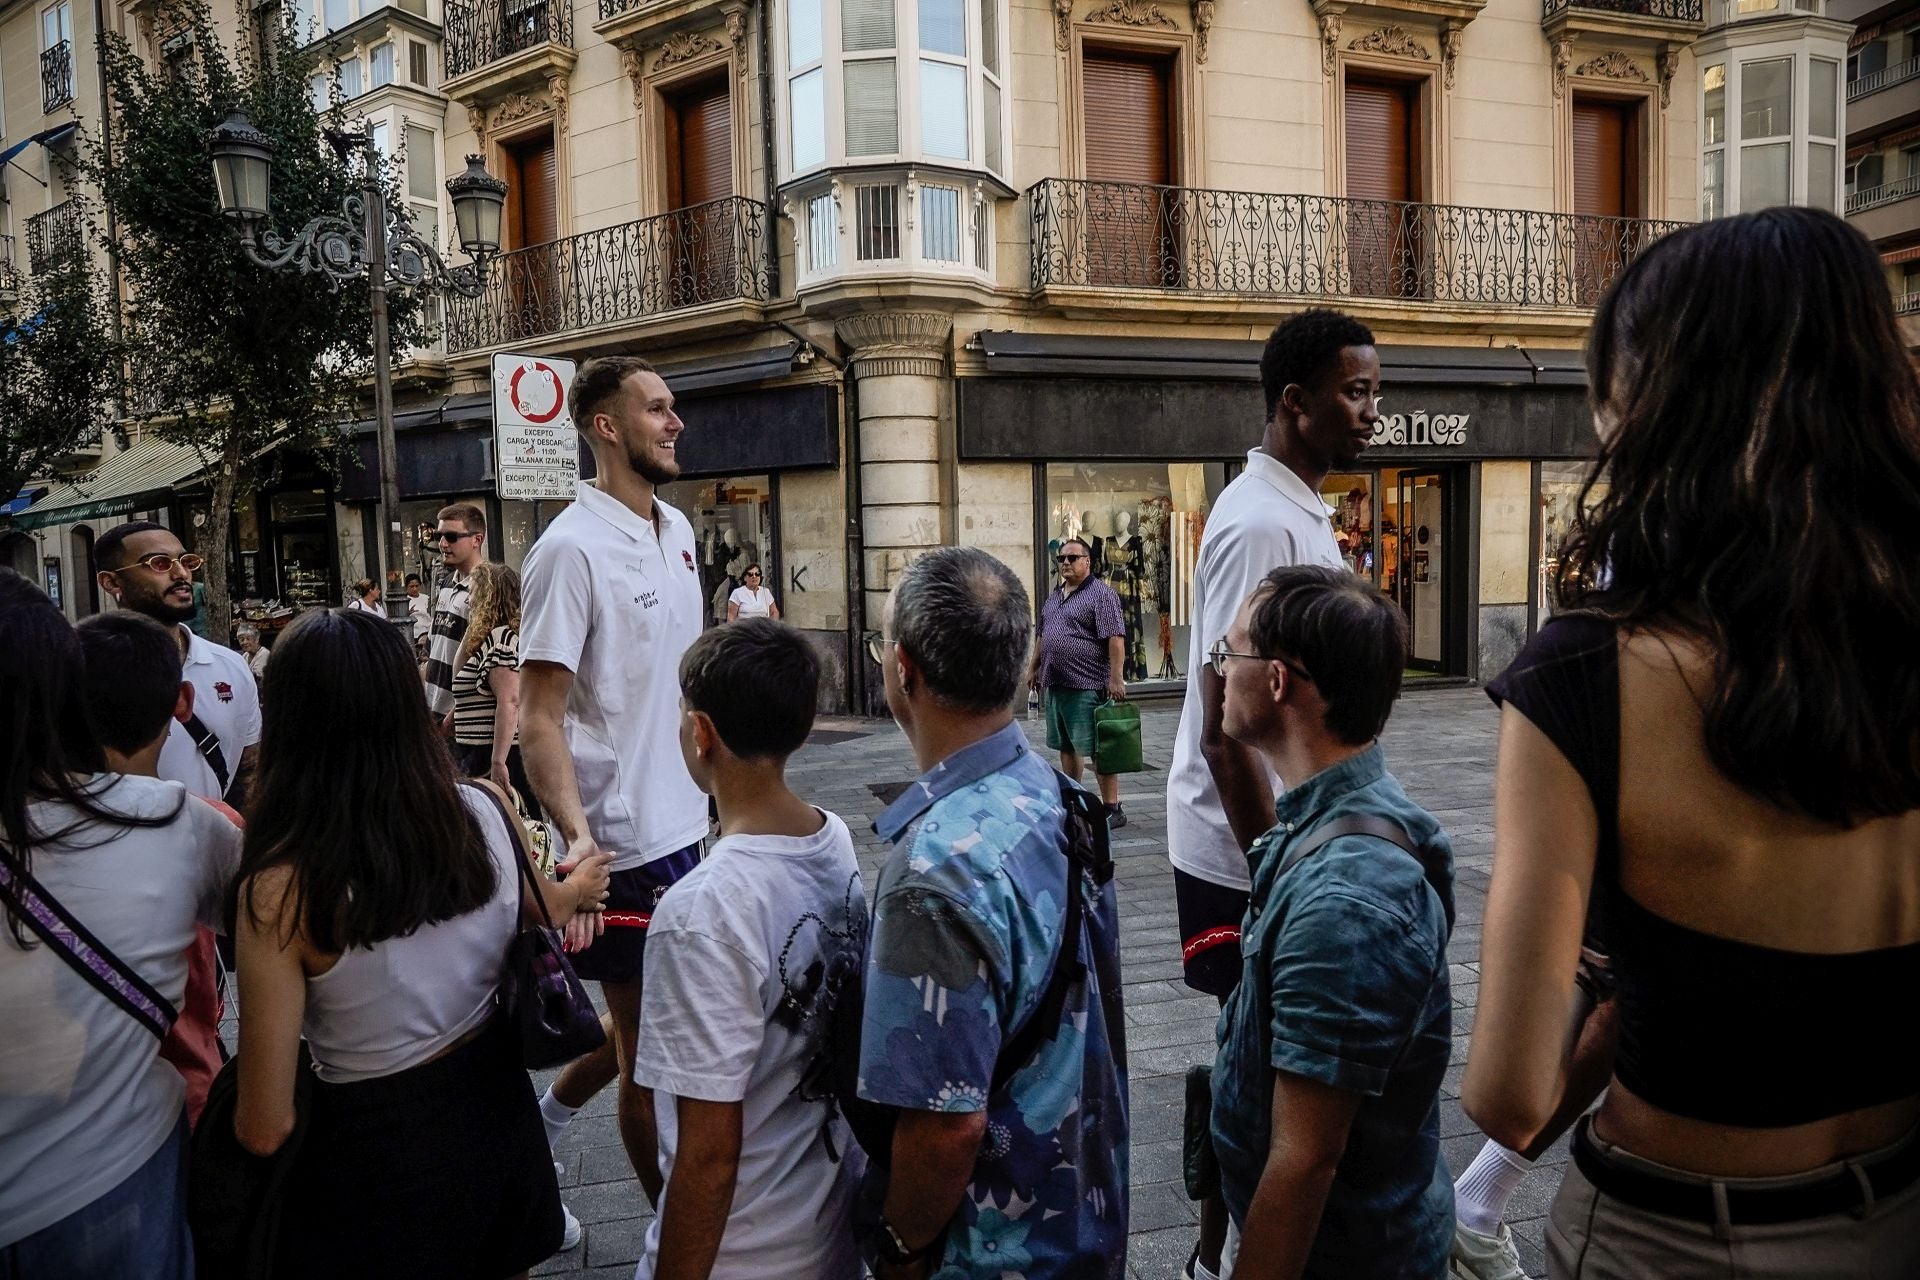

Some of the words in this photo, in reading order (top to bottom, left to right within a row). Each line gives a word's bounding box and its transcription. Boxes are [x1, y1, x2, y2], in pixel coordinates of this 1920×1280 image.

[524, 429, 554, 437] EXCEPTO
[506, 437, 530, 445] CARGA
[537, 439, 563, 447] DESCAR
[545, 457, 560, 465] IZAN
[505, 474, 535, 482] EXCEPTO
[790, 564, 808, 592] K
